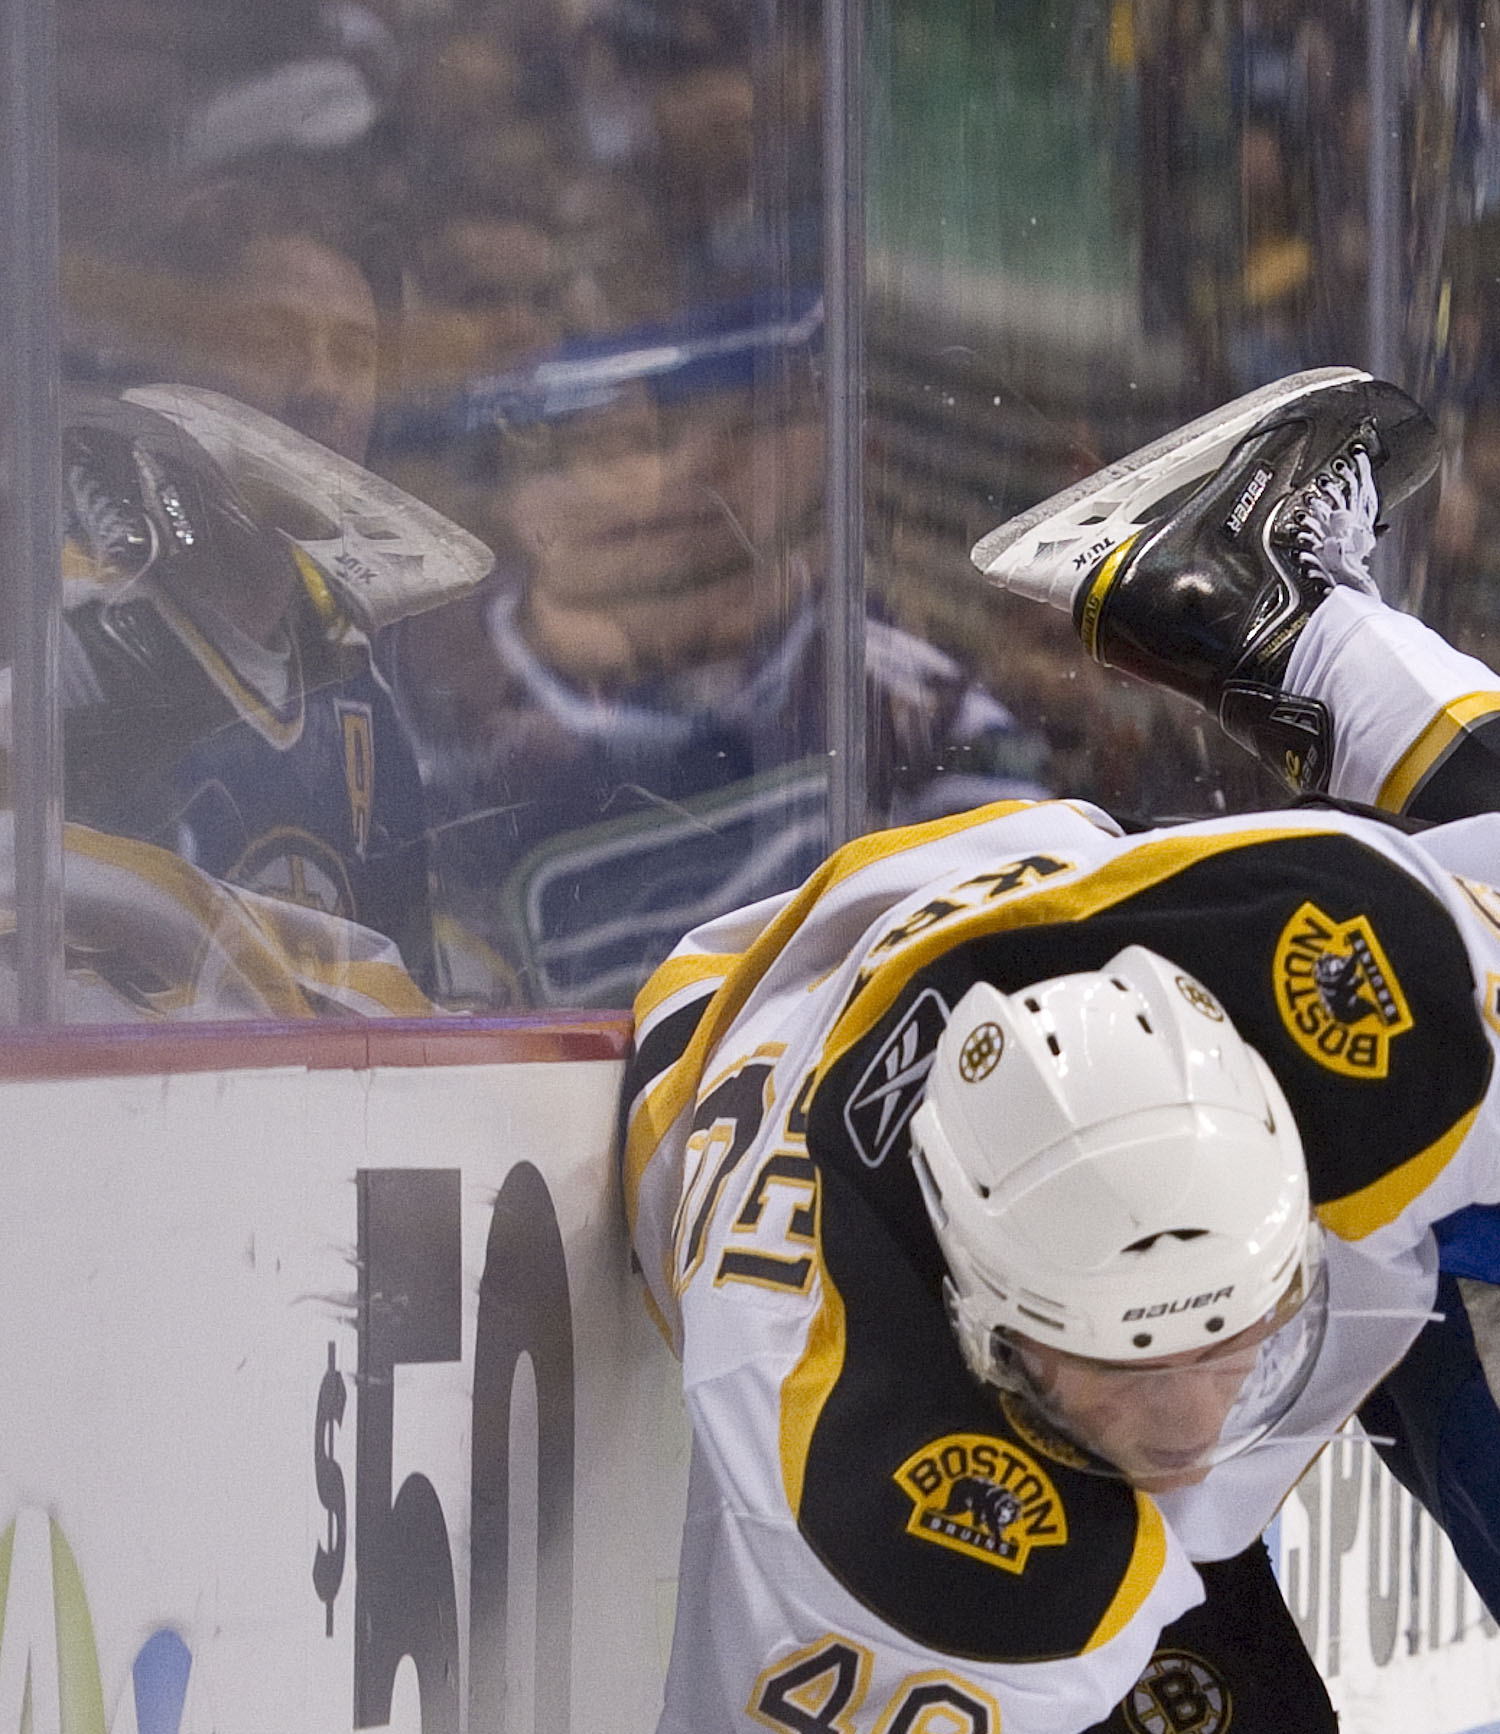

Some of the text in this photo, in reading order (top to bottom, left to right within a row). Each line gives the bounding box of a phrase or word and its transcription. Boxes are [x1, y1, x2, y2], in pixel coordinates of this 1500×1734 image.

[1225, 466, 1274, 539] BAUER
[1283, 916, 1380, 1070] BOSTON
[1121, 1286, 1235, 1323] BAUER
[906, 1444, 1058, 1538] BOSTON
